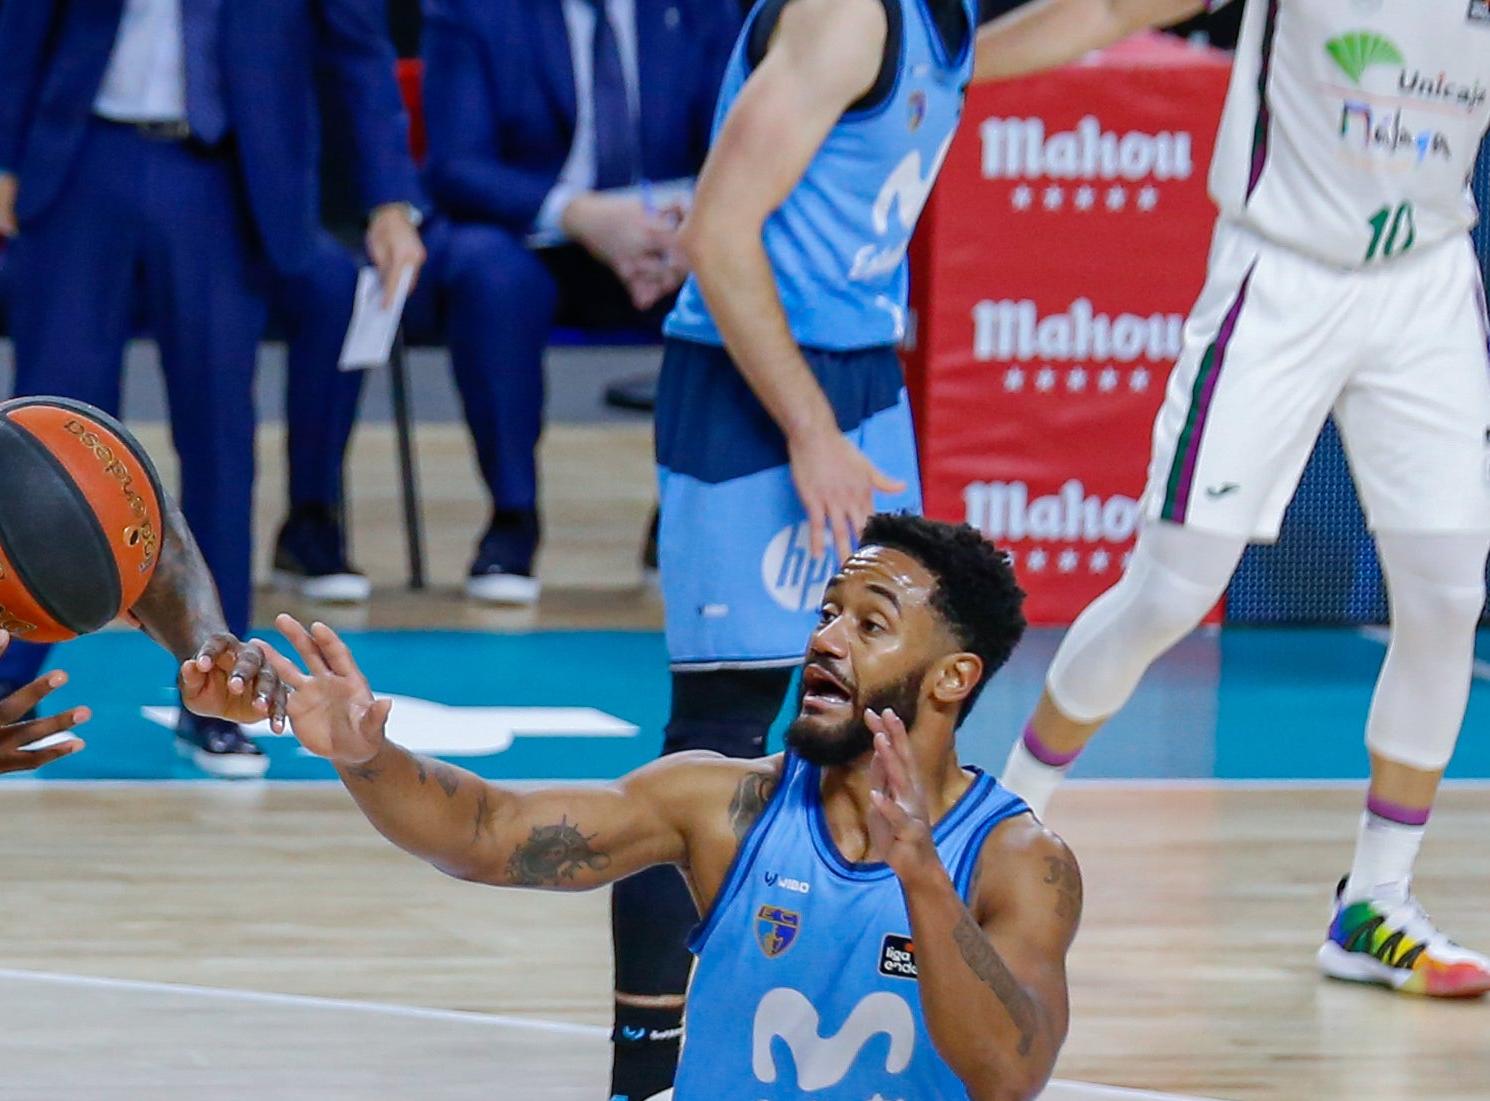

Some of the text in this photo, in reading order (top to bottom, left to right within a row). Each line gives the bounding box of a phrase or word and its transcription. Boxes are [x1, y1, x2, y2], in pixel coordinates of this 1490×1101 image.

[979, 115, 1192, 181] Mahou
[1364, 200, 1416, 262] 10
[972, 296, 1183, 362] Mahou
[964, 479, 1144, 543] Maho
[885, 945, 911, 962] liga
